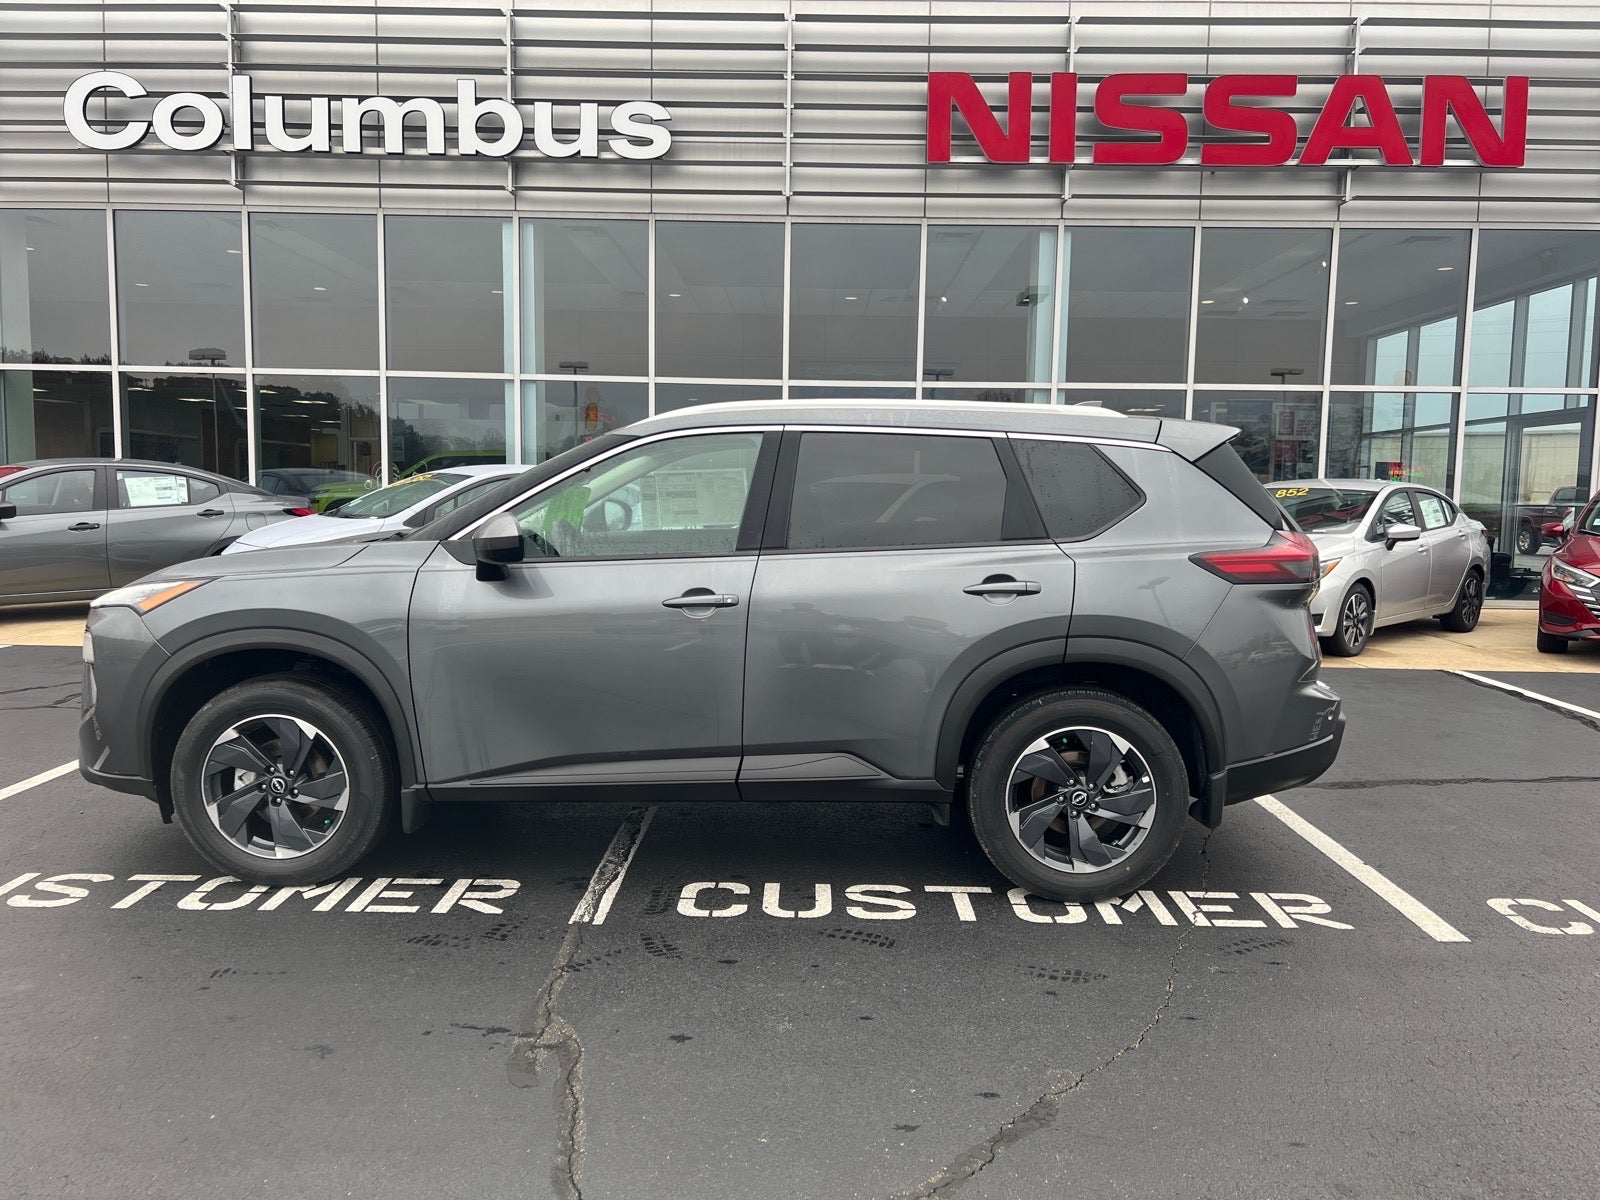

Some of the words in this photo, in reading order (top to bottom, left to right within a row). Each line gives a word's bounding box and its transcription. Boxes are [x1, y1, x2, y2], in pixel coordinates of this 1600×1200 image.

[63, 70, 674, 161] Columbus
[927, 72, 1529, 168] NISSAN
[1275, 487, 1309, 498] 852
[677, 881, 1355, 930] CUSTOMER
